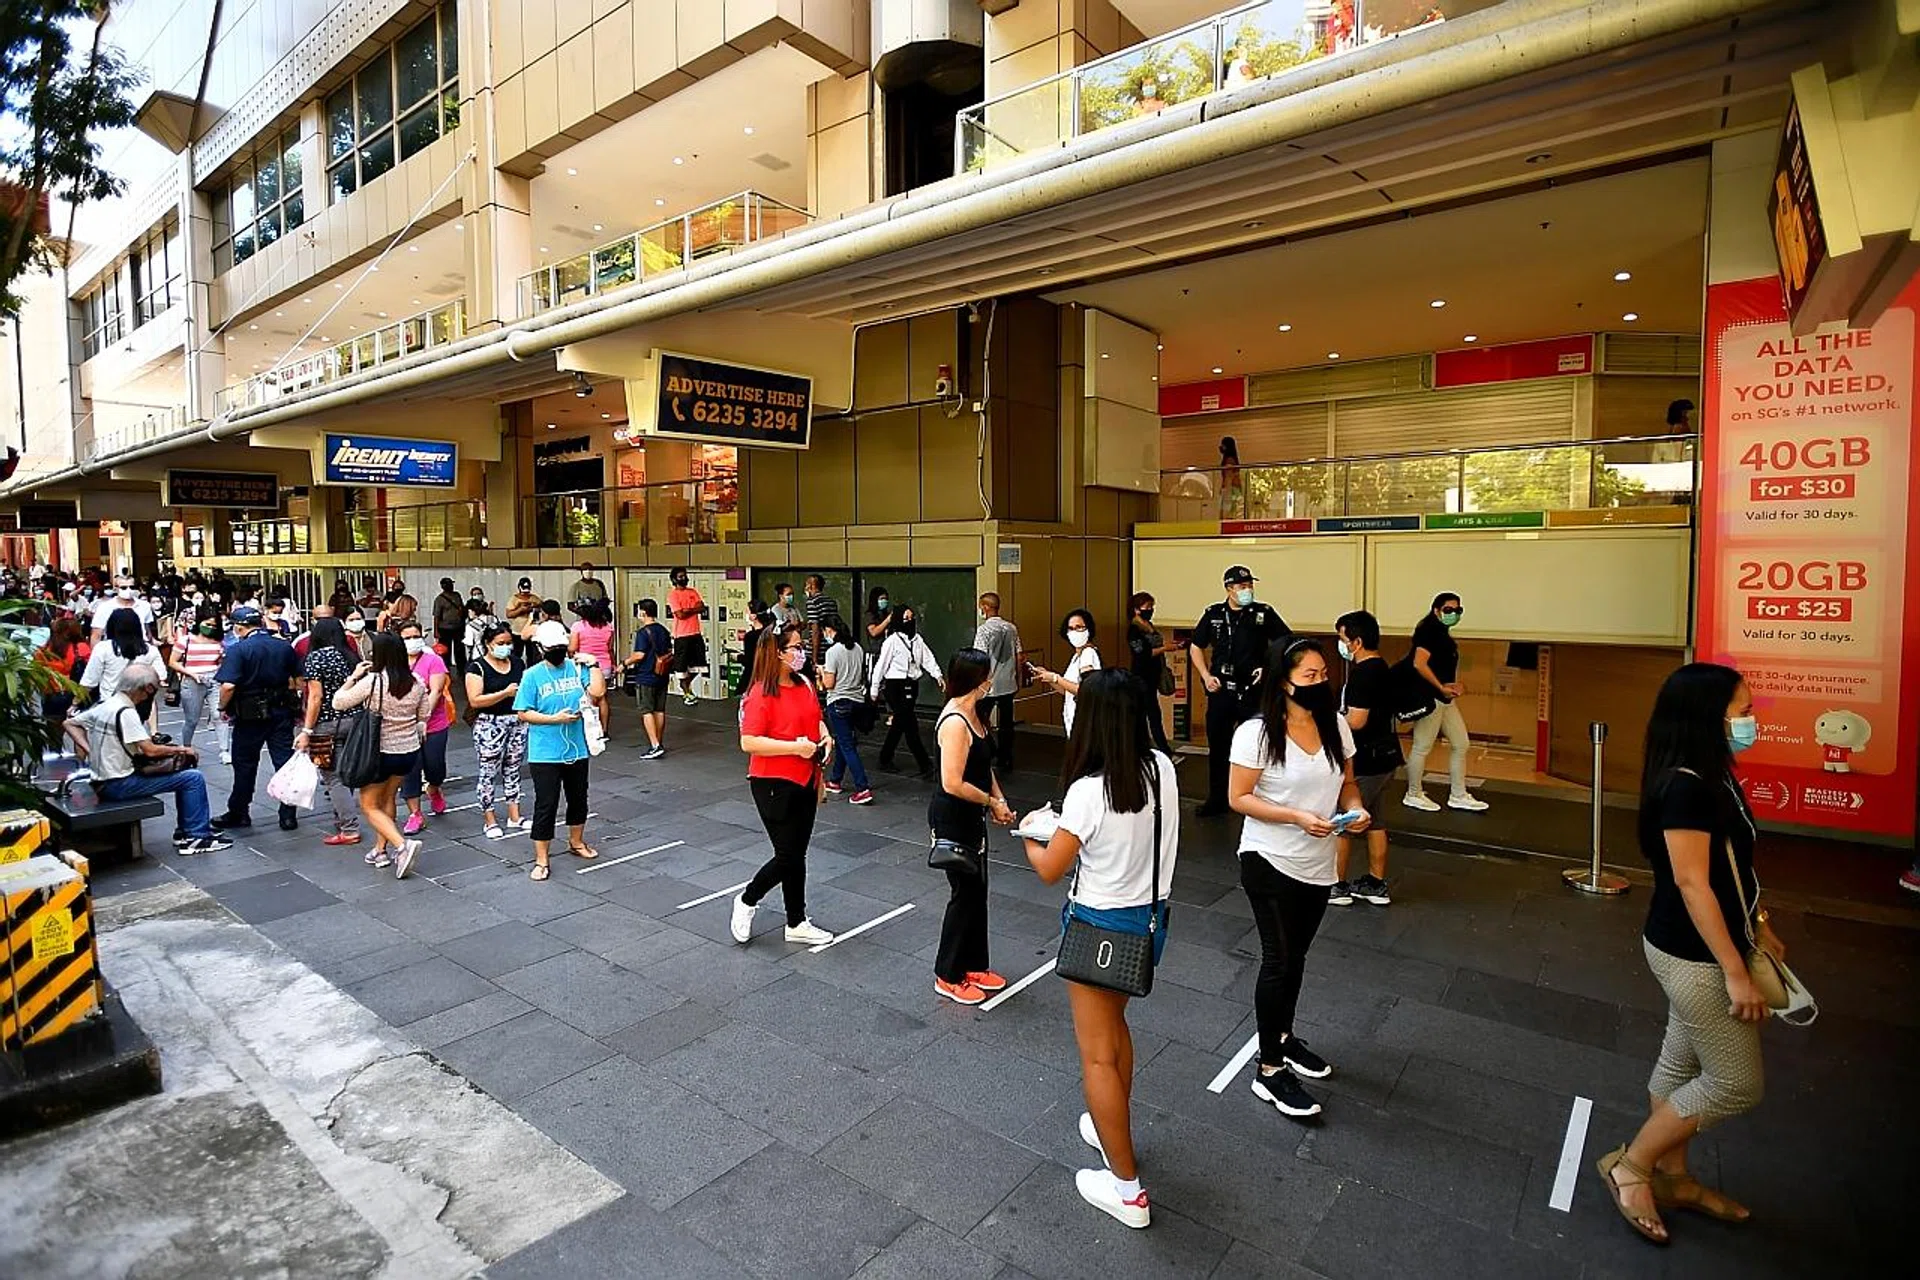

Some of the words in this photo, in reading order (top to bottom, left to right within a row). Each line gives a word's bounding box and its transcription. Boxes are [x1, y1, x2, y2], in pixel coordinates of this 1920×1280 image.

[1757, 338, 1807, 358] ALL
[1816, 329, 1872, 352] THE
[1774, 354, 1853, 378] DATA
[666, 375, 764, 403] ADVERTISE
[767, 389, 806, 409] HERE
[1734, 383, 1794, 402] YOU
[1804, 374, 1894, 398] NEED,
[692, 400, 746, 427] 6235
[751, 407, 798, 432] 3294
[1731, 409, 1752, 422] on
[1757, 406, 1790, 420] SG's
[1796, 405, 1816, 417] #1
[1822, 398, 1901, 416] network.
[1739, 436, 1871, 472] 40GB
[191, 488, 230, 500] 6235
[233, 490, 268, 501] 3294
[1758, 480, 1793, 497] for
[1800, 478, 1846, 497] $30
[1745, 510, 1777, 521] Valid
[1780, 510, 1799, 521] for
[1803, 509, 1820, 521] 30
[1823, 508, 1858, 520] days.
[1738, 560, 1868, 592] 20GB
[1755, 600, 1790, 618] for
[1797, 600, 1842, 619] $25
[1742, 629, 1775, 640] Valid
[1778, 629, 1797, 641] for
[1800, 630, 1817, 642] 30
[1820, 630, 1854, 643] days.
[1764, 671, 1806, 682] 30-day
[1765, 682, 1795, 694] daily
[1797, 685, 1823, 695] data
[1763, 724, 1788, 733] your
